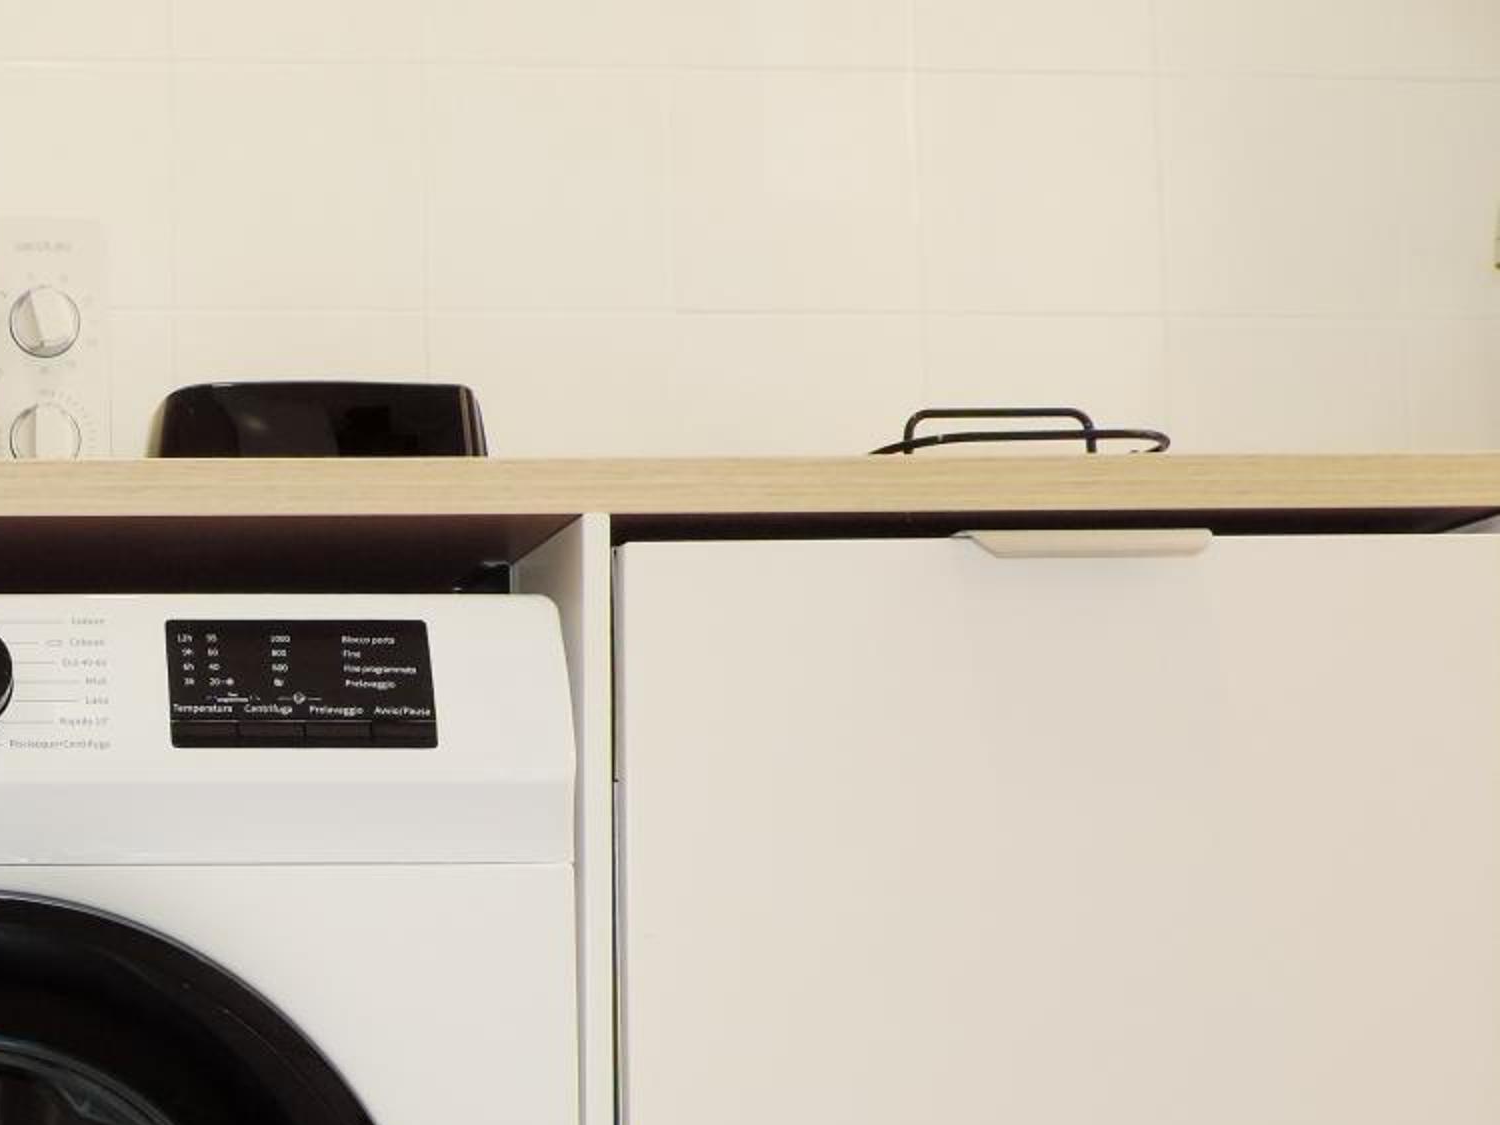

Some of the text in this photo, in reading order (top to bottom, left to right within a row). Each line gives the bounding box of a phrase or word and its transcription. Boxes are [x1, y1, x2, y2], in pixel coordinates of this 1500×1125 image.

[345, 679, 397, 690] Prelavaggio
[244, 704, 293, 715] Centrifuga
[308, 705, 364, 716] Prelavaggio
